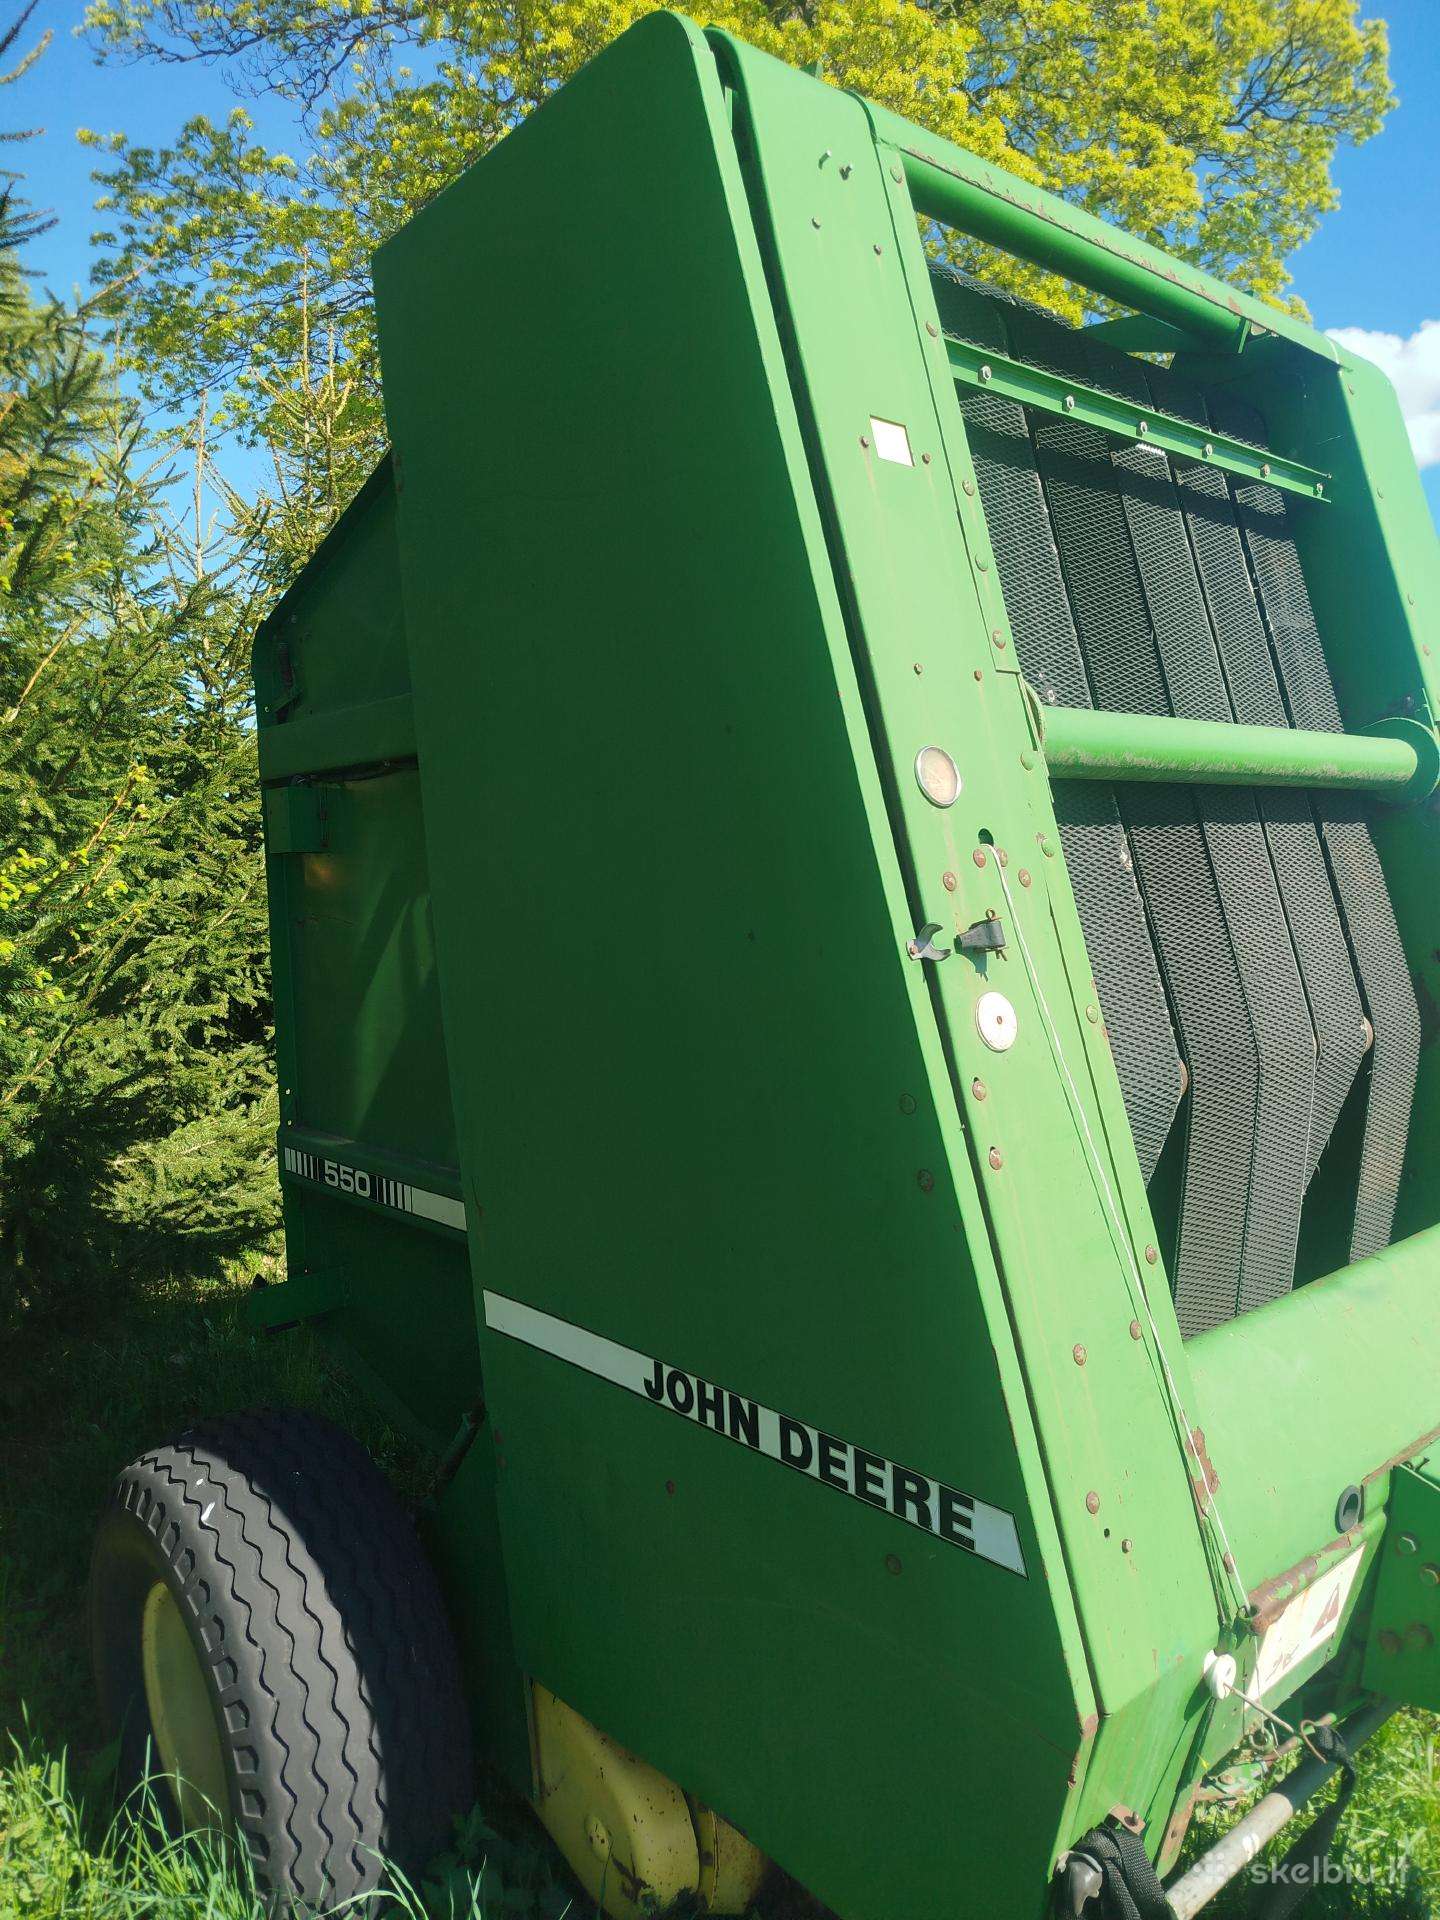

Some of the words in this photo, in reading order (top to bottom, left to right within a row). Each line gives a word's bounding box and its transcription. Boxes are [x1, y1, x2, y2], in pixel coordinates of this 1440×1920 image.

[324, 1160, 371, 1197] 550
[643, 1361, 760, 1449] JOHN
[779, 1415, 976, 1551] DEERE
